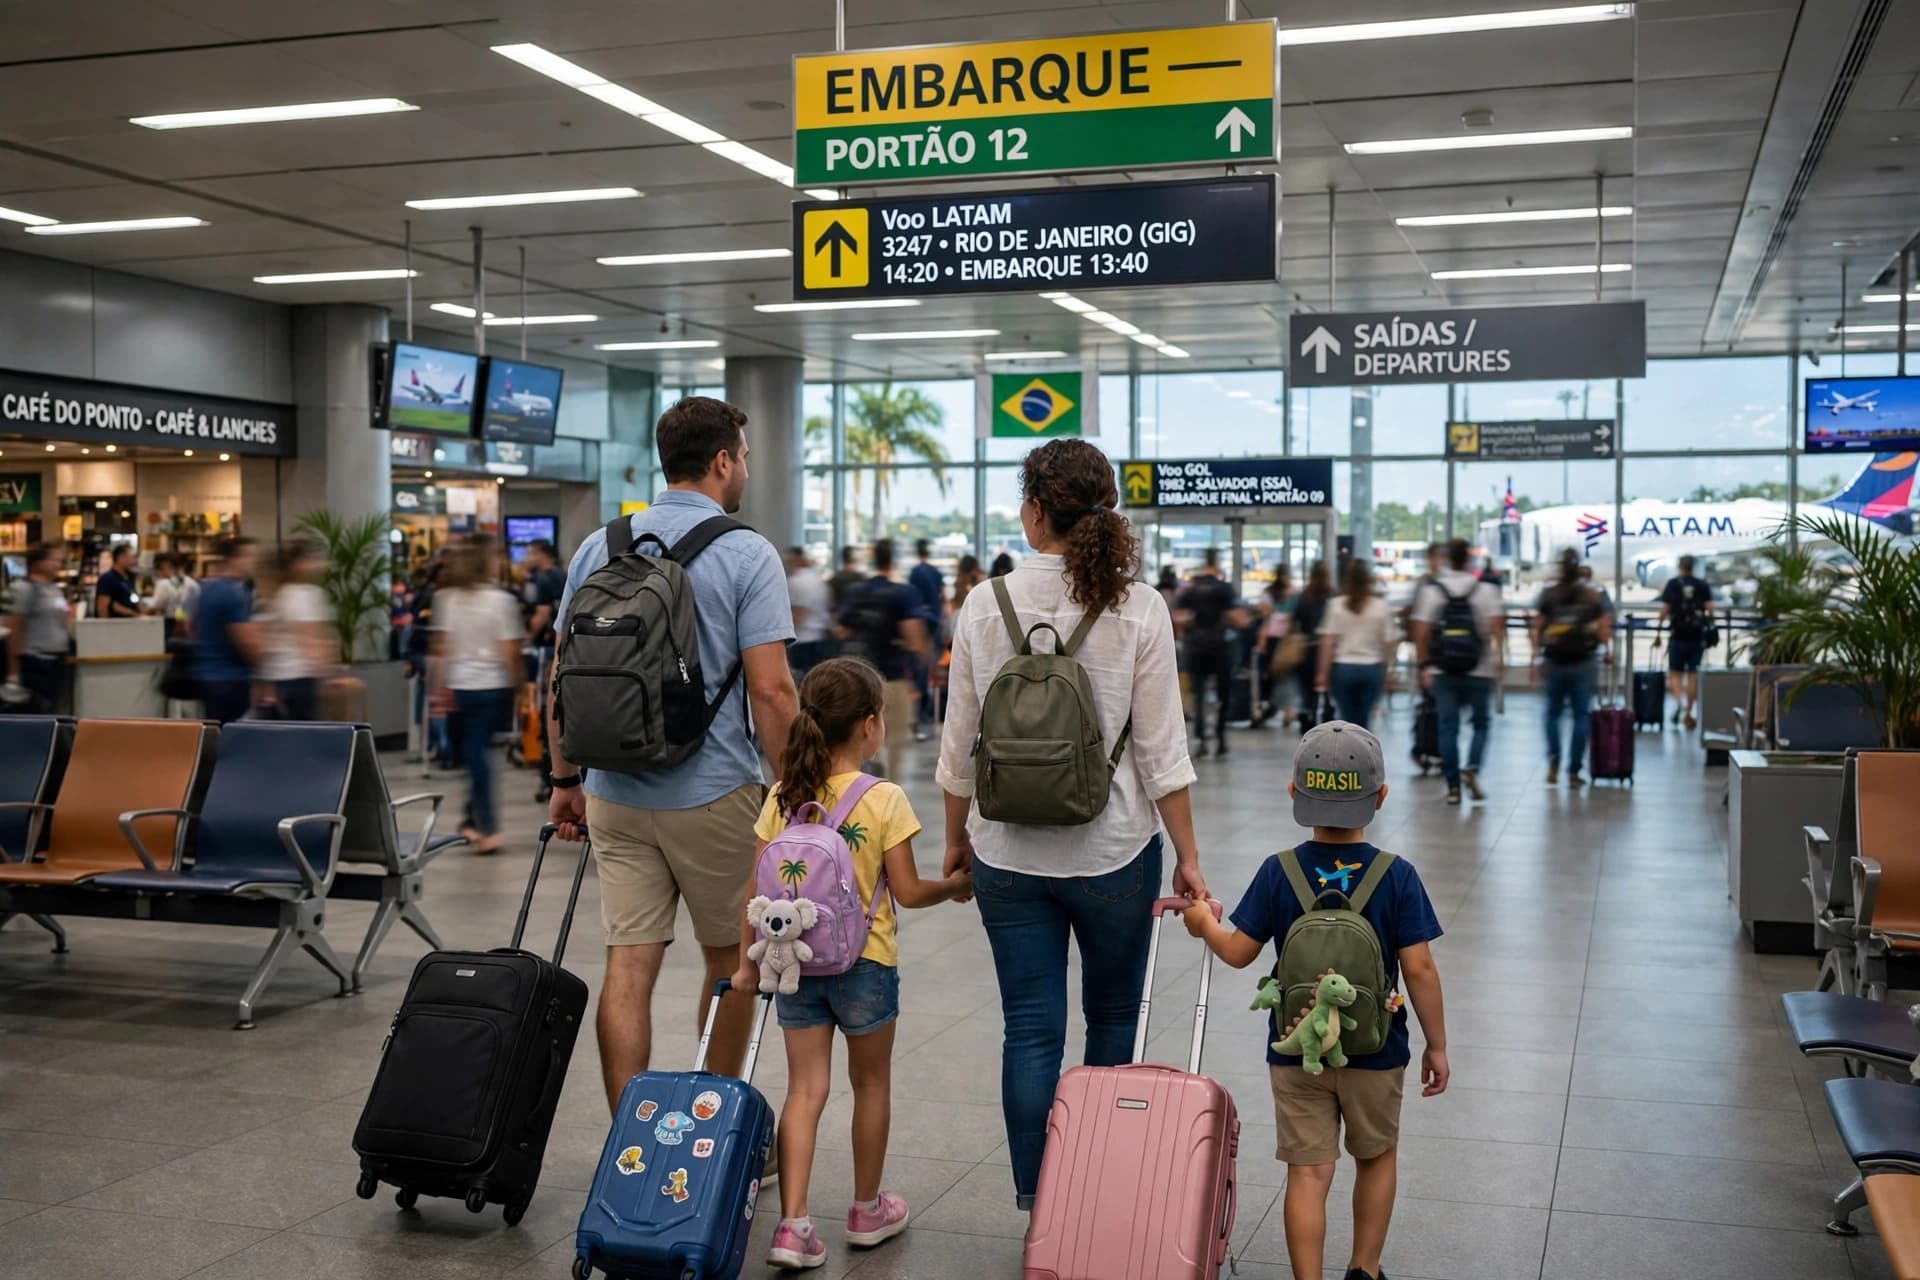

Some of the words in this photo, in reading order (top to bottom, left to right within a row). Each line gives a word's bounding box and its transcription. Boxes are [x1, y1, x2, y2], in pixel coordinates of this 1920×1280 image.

[826, 46, 1150, 115] EMBARQUE
[825, 126, 976, 171] PORTÃO
[989, 127, 1029, 161] 12
[882, 209, 925, 230] Voo
[933, 203, 1012, 227] LATAM
[882, 235, 932, 257] 3247
[955, 231, 992, 254] RIO
[1000, 229, 1029, 252] DE
[1035, 223, 1132, 251] JANEIRO
[1140, 219, 1196, 248] (GIG)
[883, 263, 939, 284] 14:20
[961, 254, 1082, 281] EMBARQUE
[1090, 251, 1149, 275] 13:40
[1354, 316, 1457, 348] SAÍDAS
[1354, 349, 1511, 376] DEPARTURES
[3, 391, 50, 422] CAFÉ
[55, 399, 82, 425] DO
[85, 403, 143, 431] PONTO
[155, 408, 195, 436] CAFÉ
[198, 414, 209, 437] &
[213, 415, 276, 444] LANCHES
[1157, 464, 1183, 477] Voo
[1185, 463, 1213, 477] GOL
[1158, 491, 1219, 506] EMBARQUE
[1221, 491, 1253, 504] FINAL
[1262, 488, 1309, 504] PORTÃO
[1195, 476, 1259, 491] SALVADOR
[1260, 476, 1293, 492] (SSA)
[1620, 515, 1736, 537] LATAM
[1306, 770, 1362, 791] BRASIL
